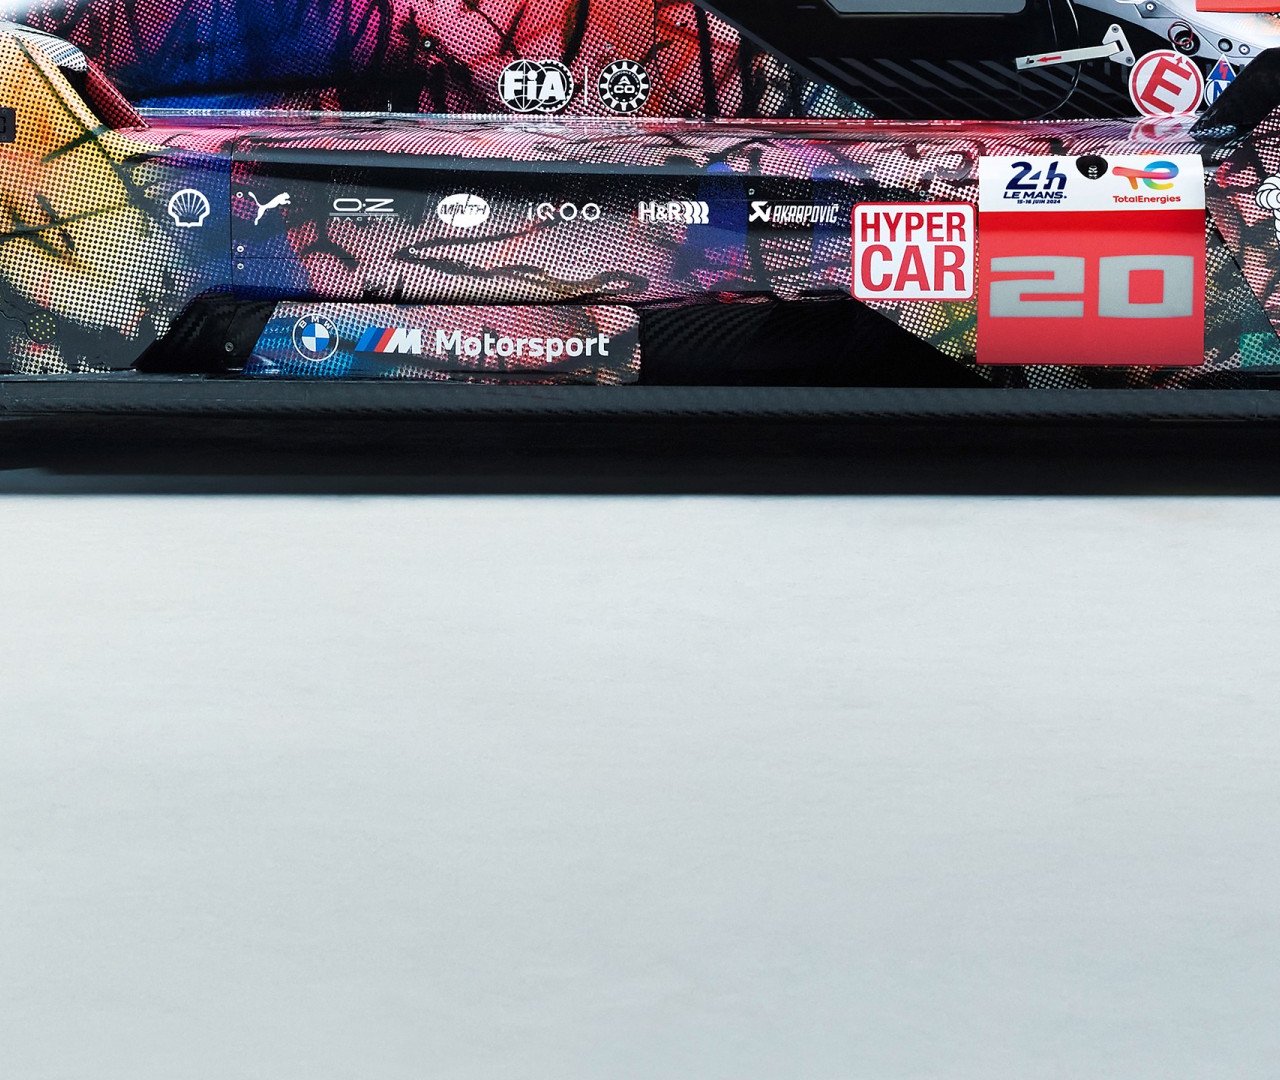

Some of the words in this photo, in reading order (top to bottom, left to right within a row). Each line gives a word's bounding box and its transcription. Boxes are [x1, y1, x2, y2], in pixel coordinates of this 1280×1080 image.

[1140, 56, 1193, 113] E
[1003, 191, 1021, 199] LE
[1113, 195, 1181, 204] TotalEnergies
[860, 212, 966, 242] HYPER
[860, 244, 966, 292] CAR
[989, 255, 1194, 318] 20
[435, 329, 610, 362] Motorsport
